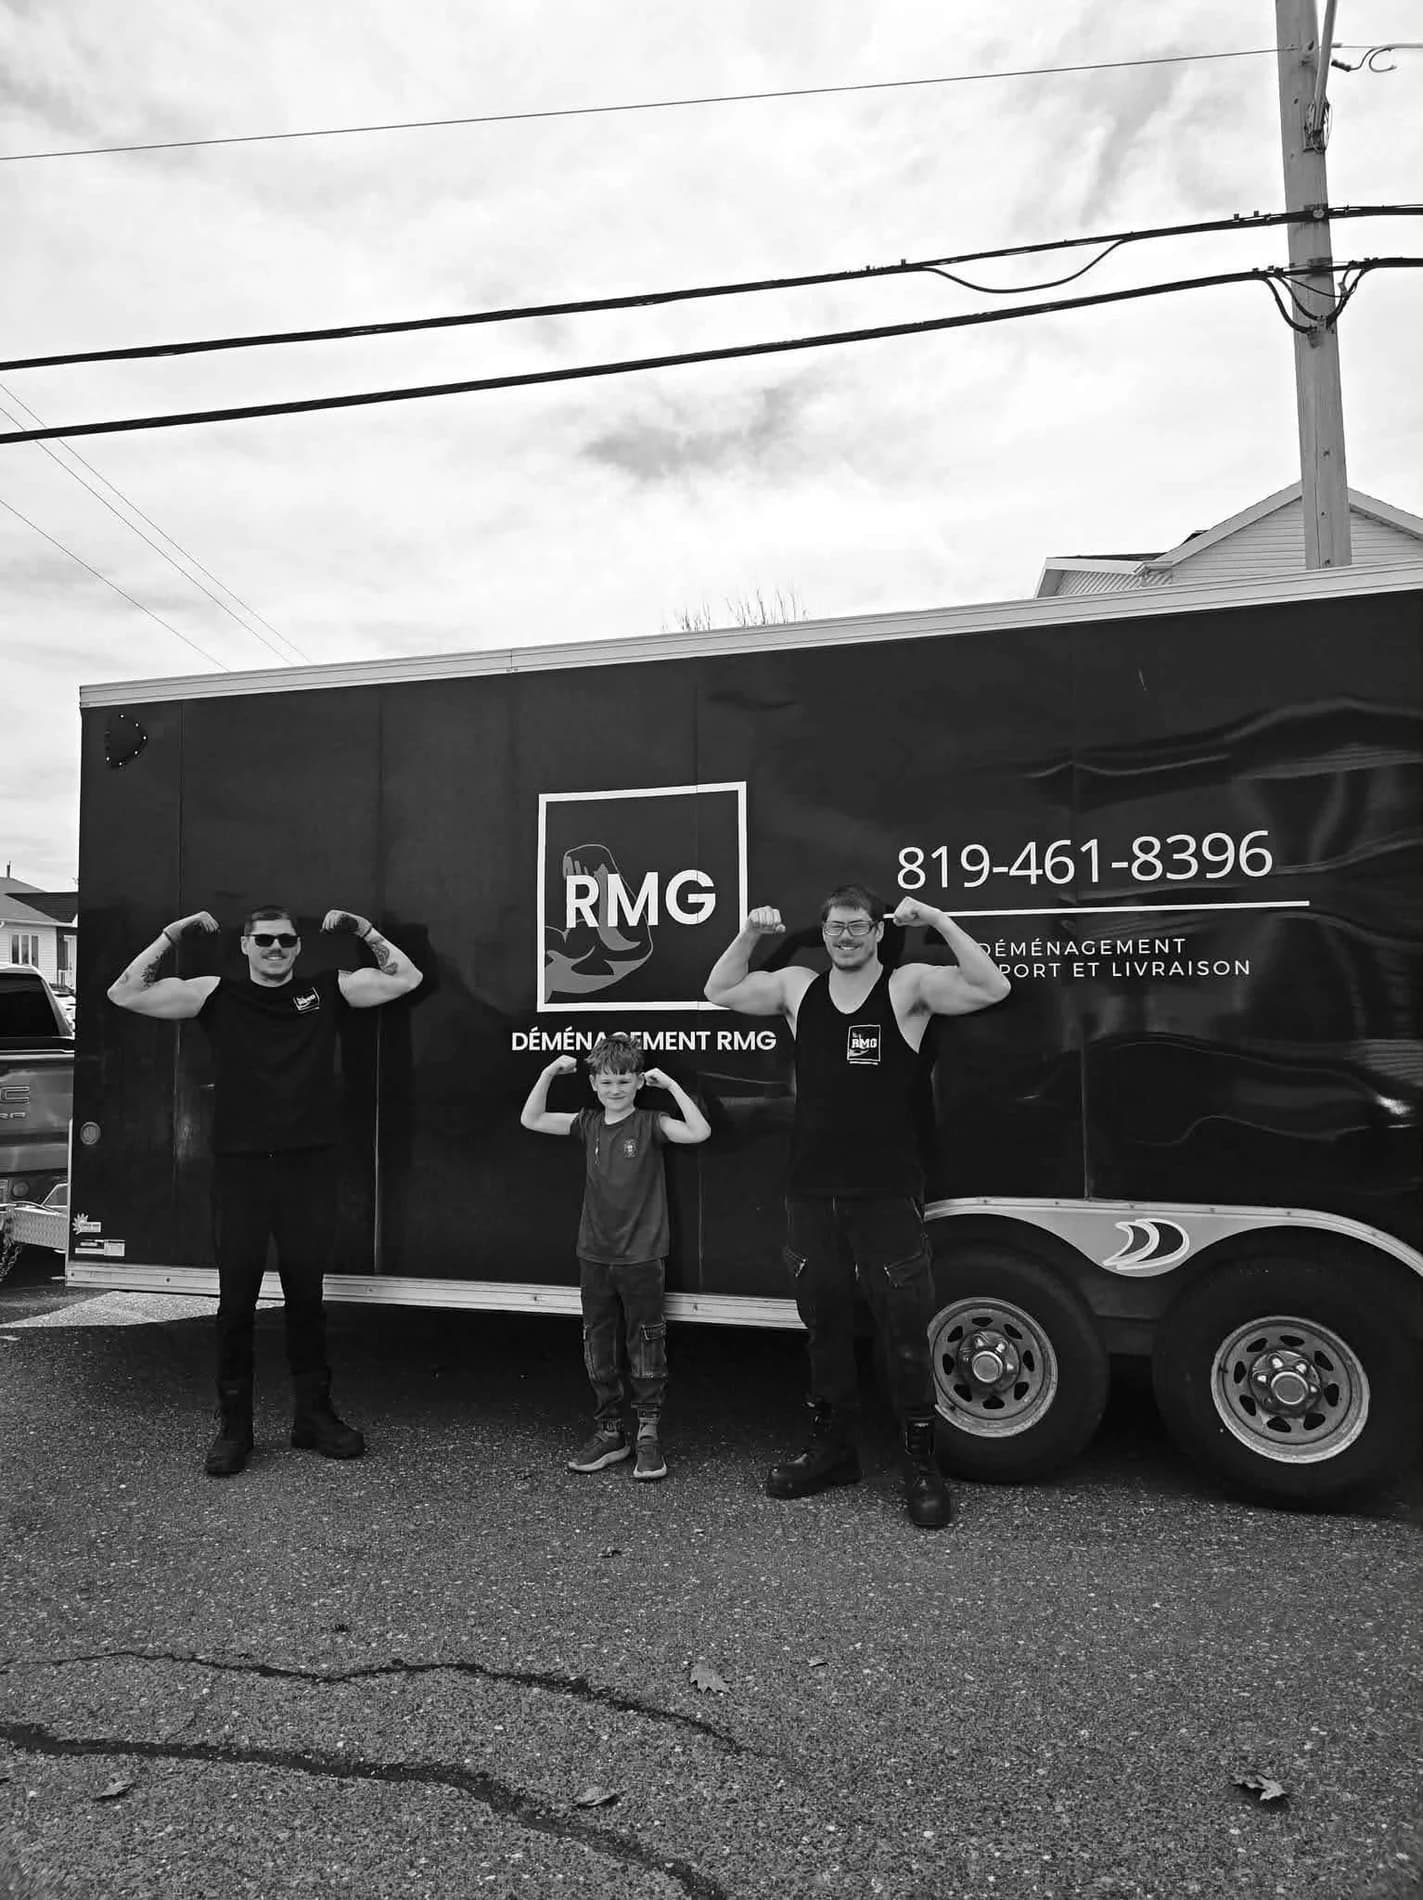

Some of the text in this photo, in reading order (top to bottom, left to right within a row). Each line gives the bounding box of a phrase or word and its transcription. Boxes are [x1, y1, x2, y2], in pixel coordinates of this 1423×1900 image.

[897, 830, 1273, 890] 819-461-8396
[566, 869, 717, 929] RMG
[1073, 962, 1100, 977] ET
[1112, 960, 1250, 977] LIVRAISON
[717, 1031, 777, 1051] RMG
